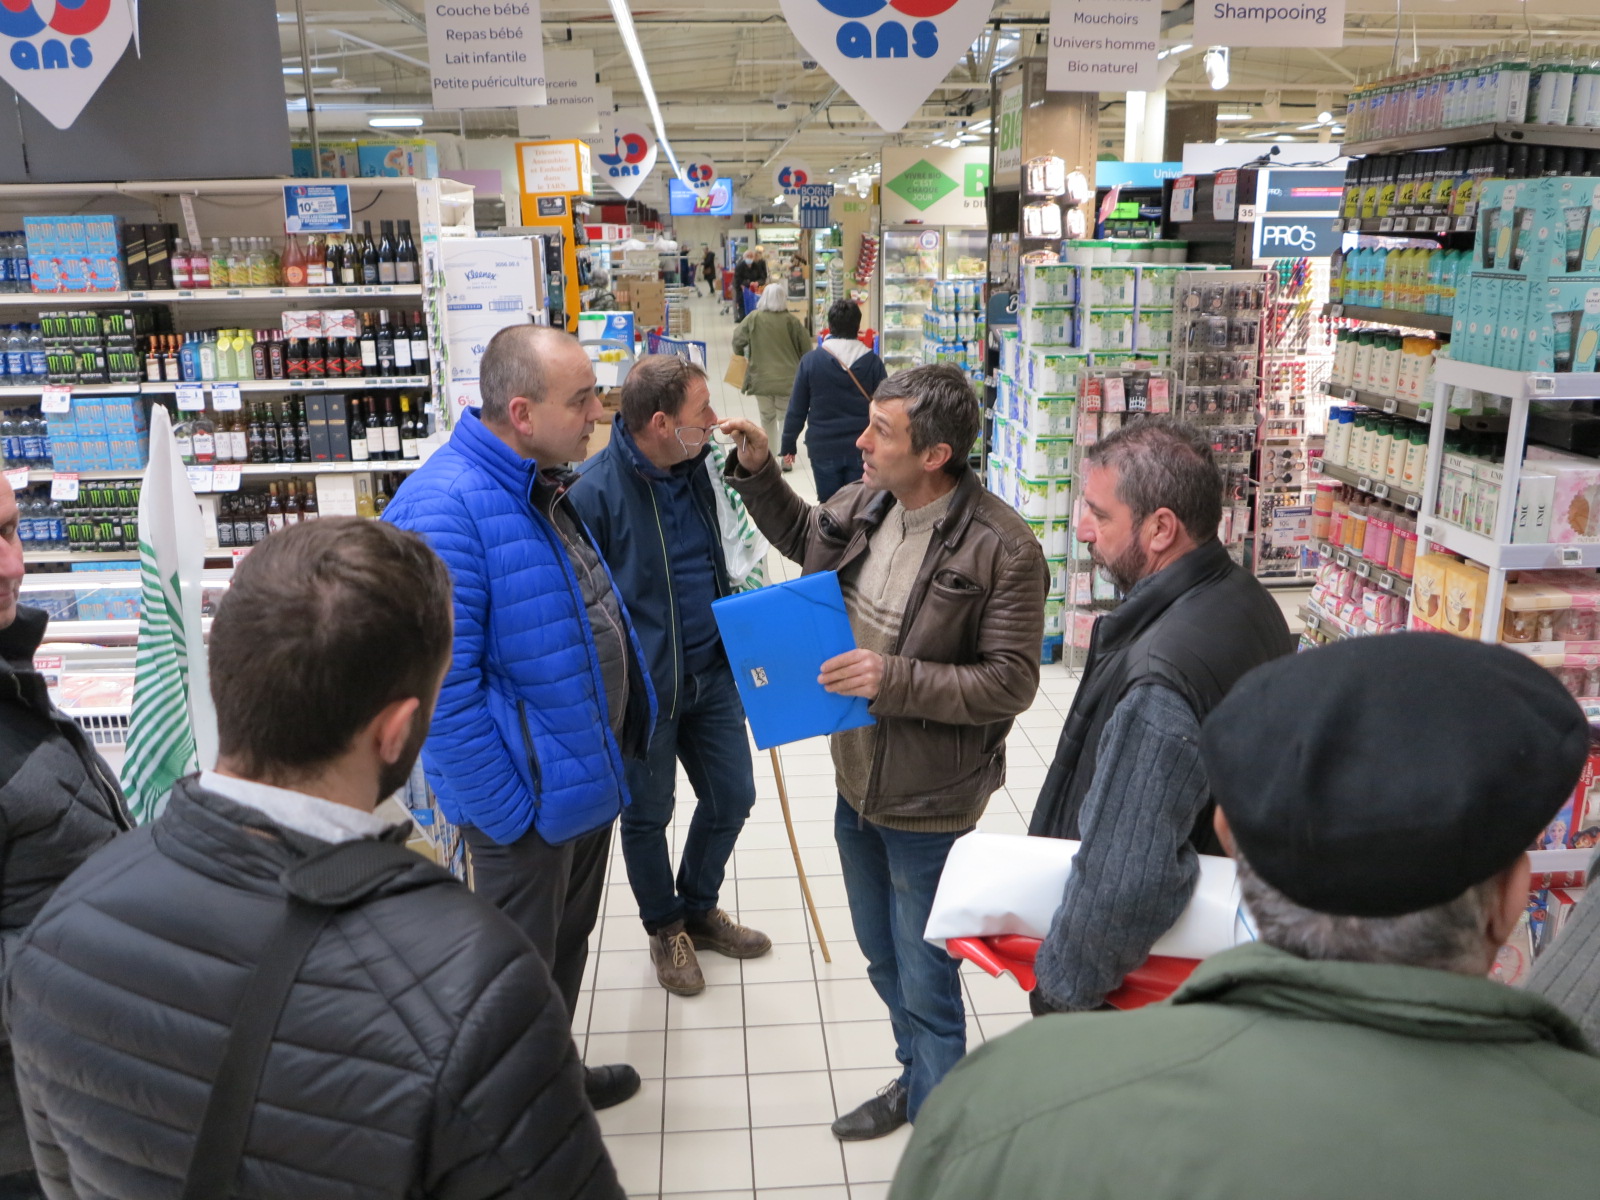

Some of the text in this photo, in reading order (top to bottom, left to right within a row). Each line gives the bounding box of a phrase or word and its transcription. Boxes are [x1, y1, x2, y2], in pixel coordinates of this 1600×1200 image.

[436, 2, 530, 17] Couche bébé
[1213, 3, 1328, 24] Shampooing
[1073, 12, 1139, 25] Mouchoirs
[446, 26, 523, 43] Repas bébé
[836, 20, 939, 59] ans
[1053, 36, 1156, 51] Univers homme
[10, 37, 93, 71] ans
[445, 51, 527, 64] Lait infantile
[1068, 60, 1138, 74] Bio naturel
[433, 75, 545, 91] Petite puériculture
[559, 96, 594, 106] maison
[906, 186, 939, 194] CHAQUE
[912, 179, 932, 187] C'EST
[801, 186, 833, 197] BORNE
[912, 193, 933, 201] JOUR
[801, 196, 829, 208] PRIX
[1241, 209, 1254, 218] 35
[1263, 225, 1316, 251] PRO'S
[465, 269, 497, 282] Kleenex
[1519, 504, 1529, 528] UNIC
[1535, 504, 1546, 527] UNIC
